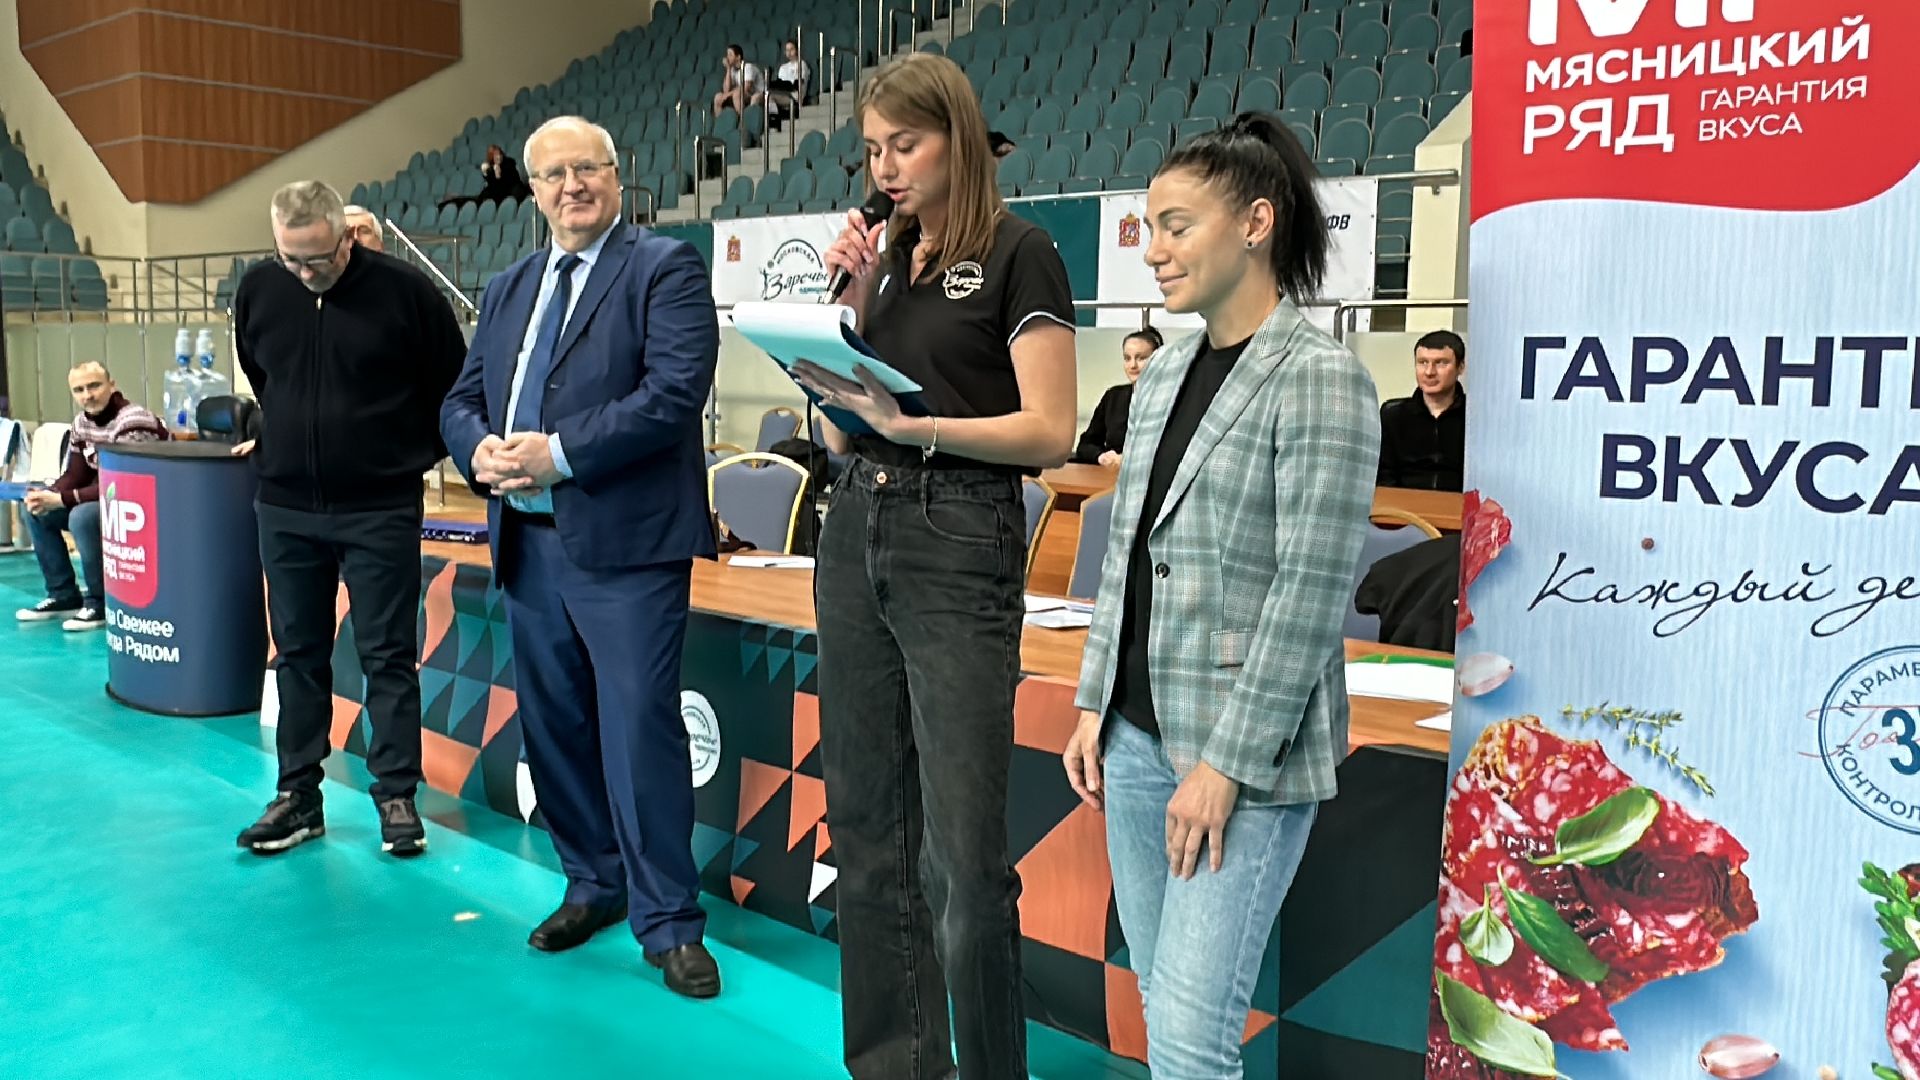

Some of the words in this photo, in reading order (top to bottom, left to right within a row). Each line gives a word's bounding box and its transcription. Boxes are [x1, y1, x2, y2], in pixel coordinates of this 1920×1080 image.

[1526, 15, 1870, 92] МЯСНИЦКИЙ
[1700, 76, 1867, 111] ГАРАНТИЯ
[1523, 94, 1675, 155] РЯД
[1698, 112, 1803, 141] ВКУСА
[1327, 214, 1351, 230] ФВ
[1520, 336, 1920, 409] ГАРАНТ
[1600, 433, 1920, 515] ВКУСА
[117, 608, 174, 638] Свежее
[1527, 552, 1836, 638] Каждый
[125, 635, 180, 663] Рядом
[1881, 706, 1920, 776] 3
